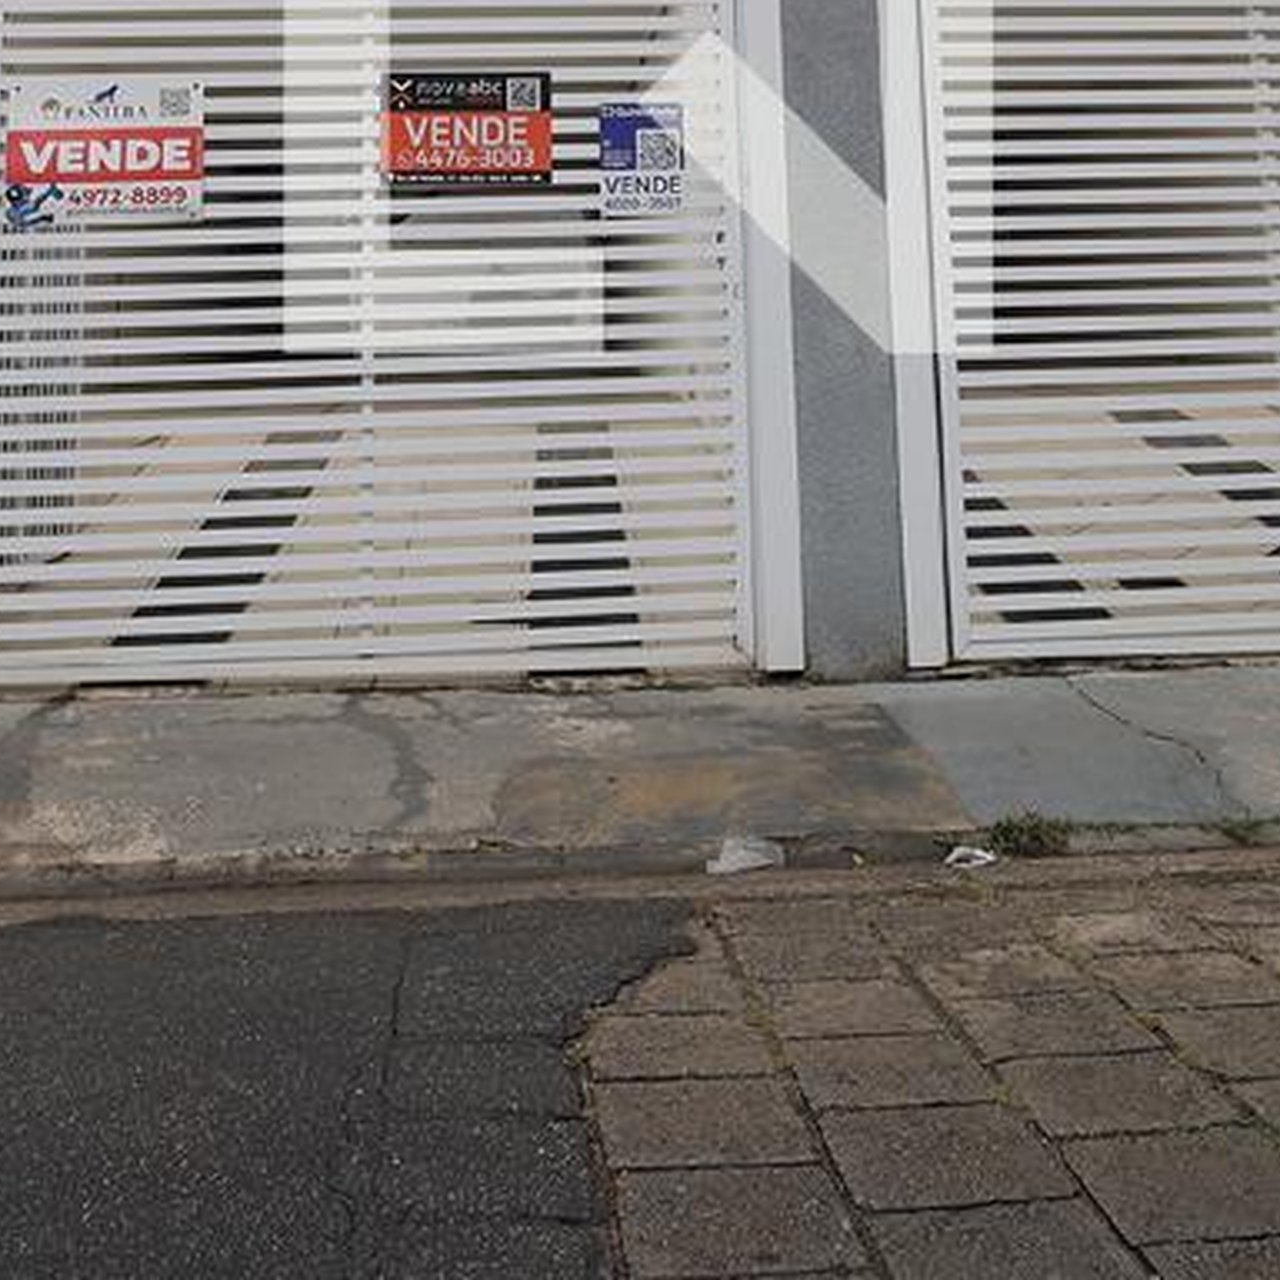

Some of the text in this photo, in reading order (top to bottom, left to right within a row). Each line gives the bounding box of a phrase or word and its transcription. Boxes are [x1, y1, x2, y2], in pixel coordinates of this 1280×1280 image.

[404, 116, 528, 147] VENDE
[20, 139, 192, 173] VENDE
[69, 186, 188, 206] 4972-8899
[604, 176, 682, 194] VENDE
